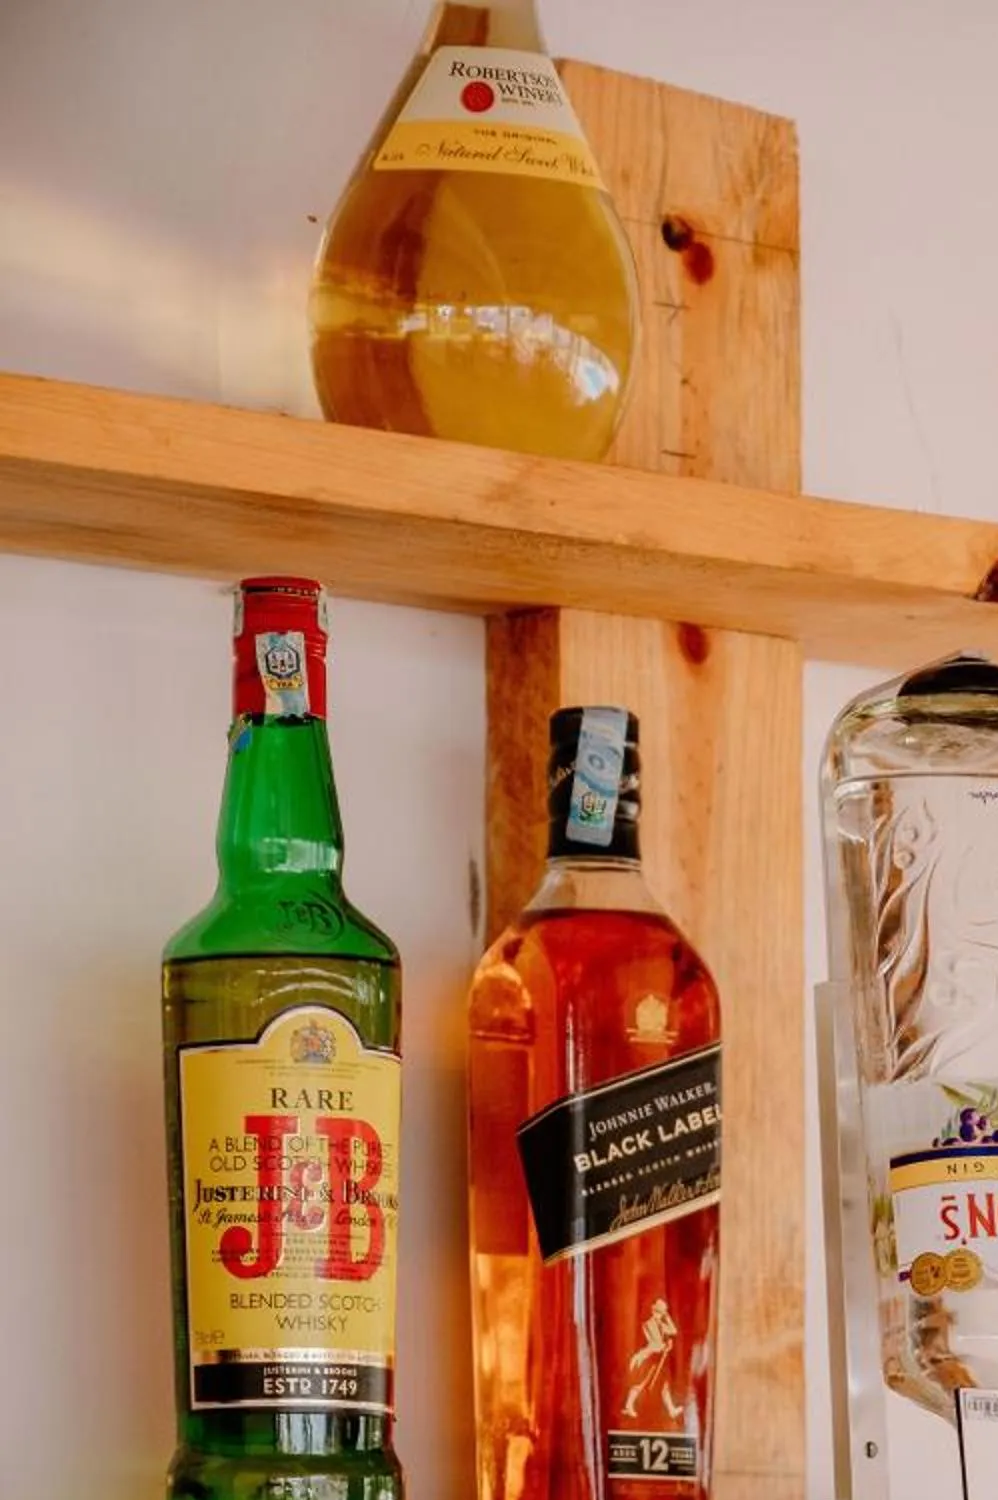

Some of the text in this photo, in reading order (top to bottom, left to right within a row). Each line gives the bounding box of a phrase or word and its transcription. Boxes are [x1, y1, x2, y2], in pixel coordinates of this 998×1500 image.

[270, 1086, 354, 1112] RARE
[589, 1103, 655, 1142] JOHNNIE
[208, 1137, 221, 1154] A
[224, 1136, 283, 1154] BLEND
[572, 1103, 723, 1174] BLACK LABEL
[209, 1155, 247, 1173] OLD
[945, 1160, 985, 1175] GIN
[230, 1293, 314, 1311] BLENDED
[274, 1314, 349, 1333] WHISKY
[320, 1378, 358, 1397] 1749
[640, 1438, 669, 1473] 12
